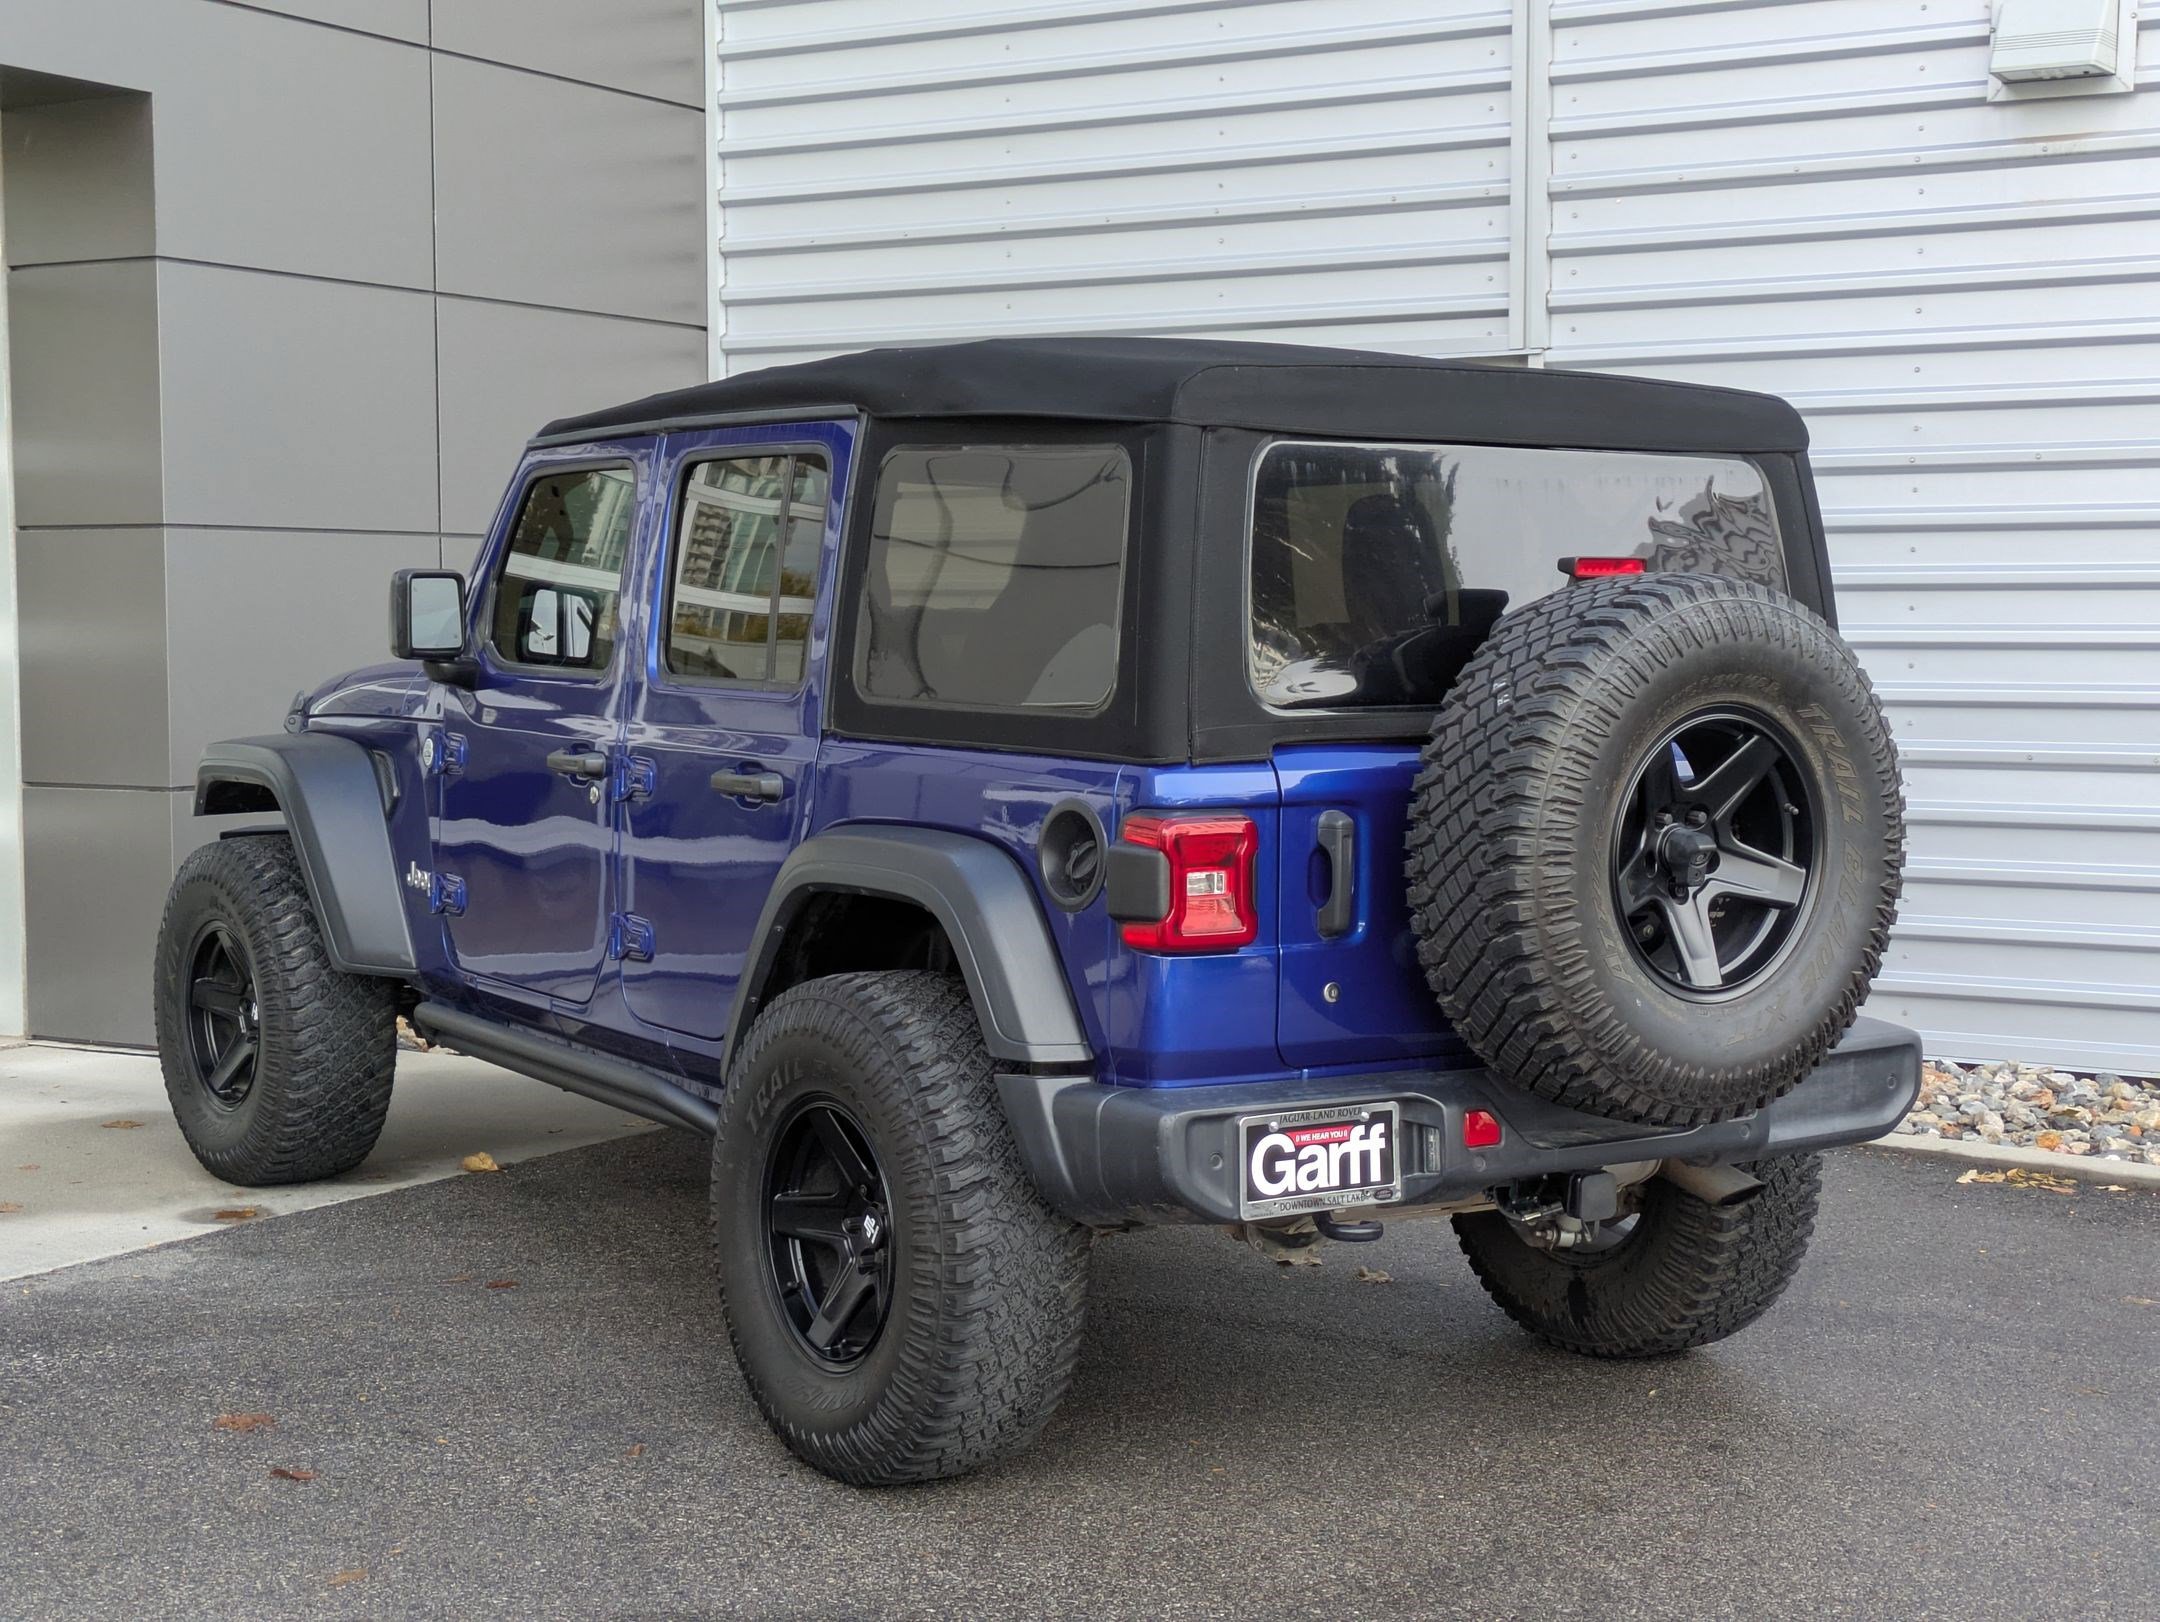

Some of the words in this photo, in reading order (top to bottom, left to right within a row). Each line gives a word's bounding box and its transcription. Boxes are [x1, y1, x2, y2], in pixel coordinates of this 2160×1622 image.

[1797, 703, 1863, 825] TRAIL
[1301, 1133, 1311, 1142] WE
[1311, 1132, 1329, 1141] HEAR
[1330, 1130, 1343, 1139] YOU
[1251, 1123, 1386, 1196] Garff
[1280, 1198, 1326, 1212] DOWNTOWN
[1327, 1195, 1345, 1206] SALT
